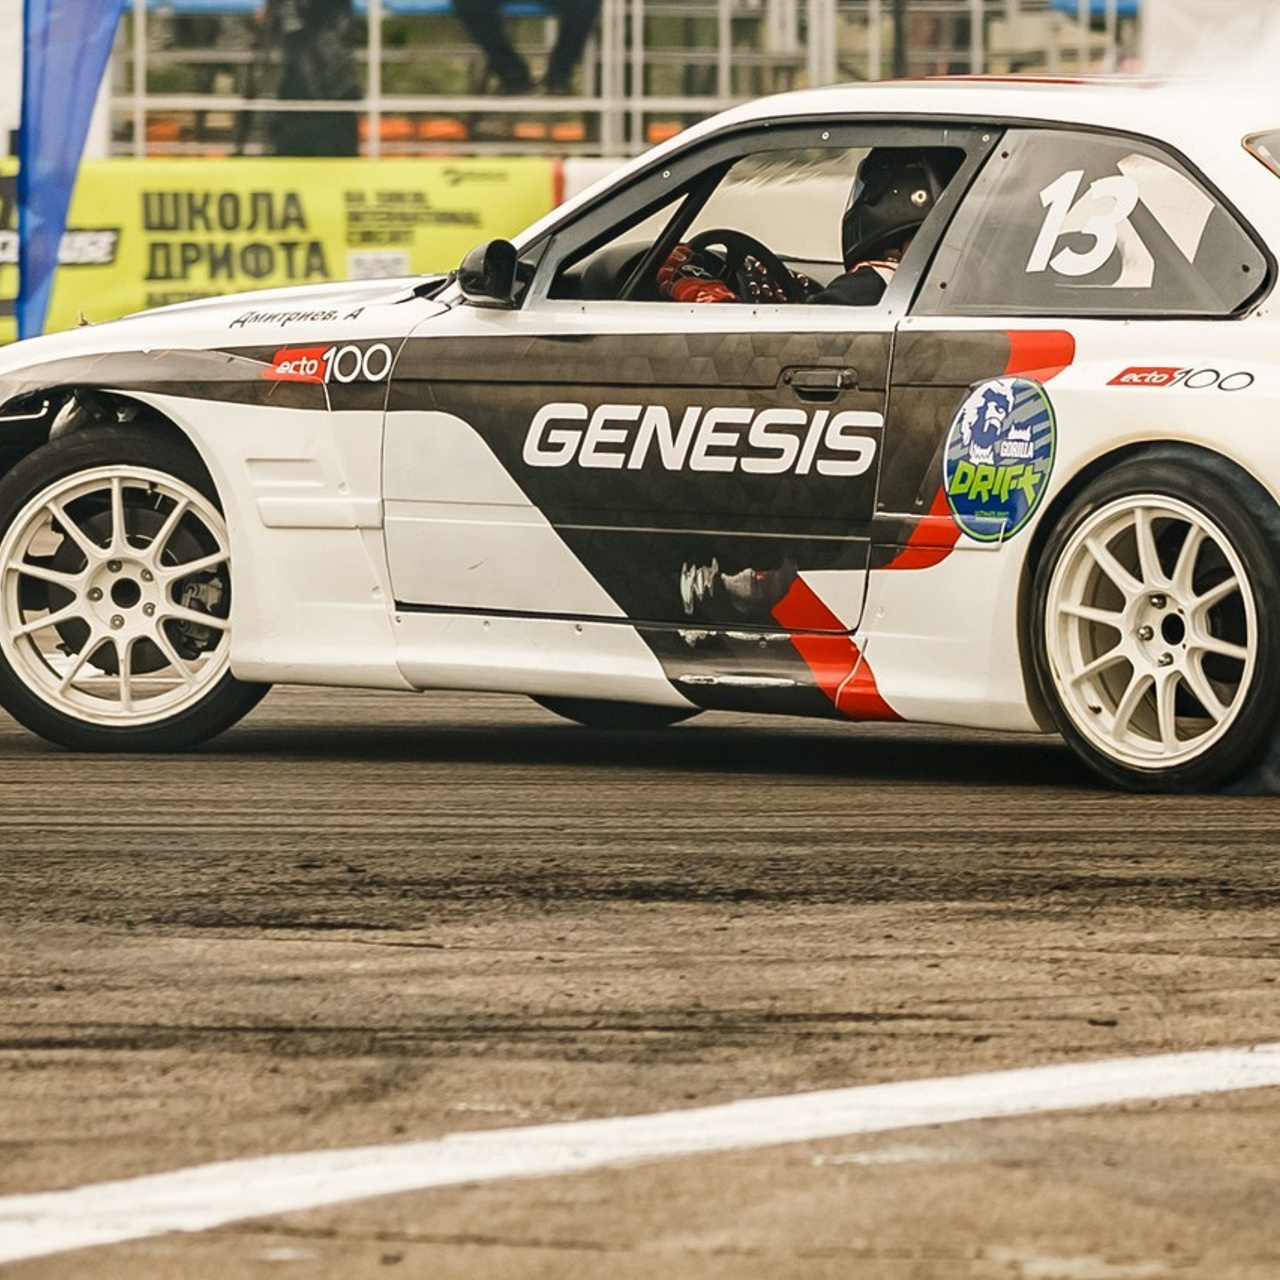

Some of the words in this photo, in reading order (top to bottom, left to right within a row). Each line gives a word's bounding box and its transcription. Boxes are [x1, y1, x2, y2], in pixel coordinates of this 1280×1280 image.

[142, 192, 307, 232] ШКОЛА
[144, 241, 332, 281] ДРИФТА
[522, 402, 885, 476] GENESIS
[1000, 440, 1035, 459] GORILLA
